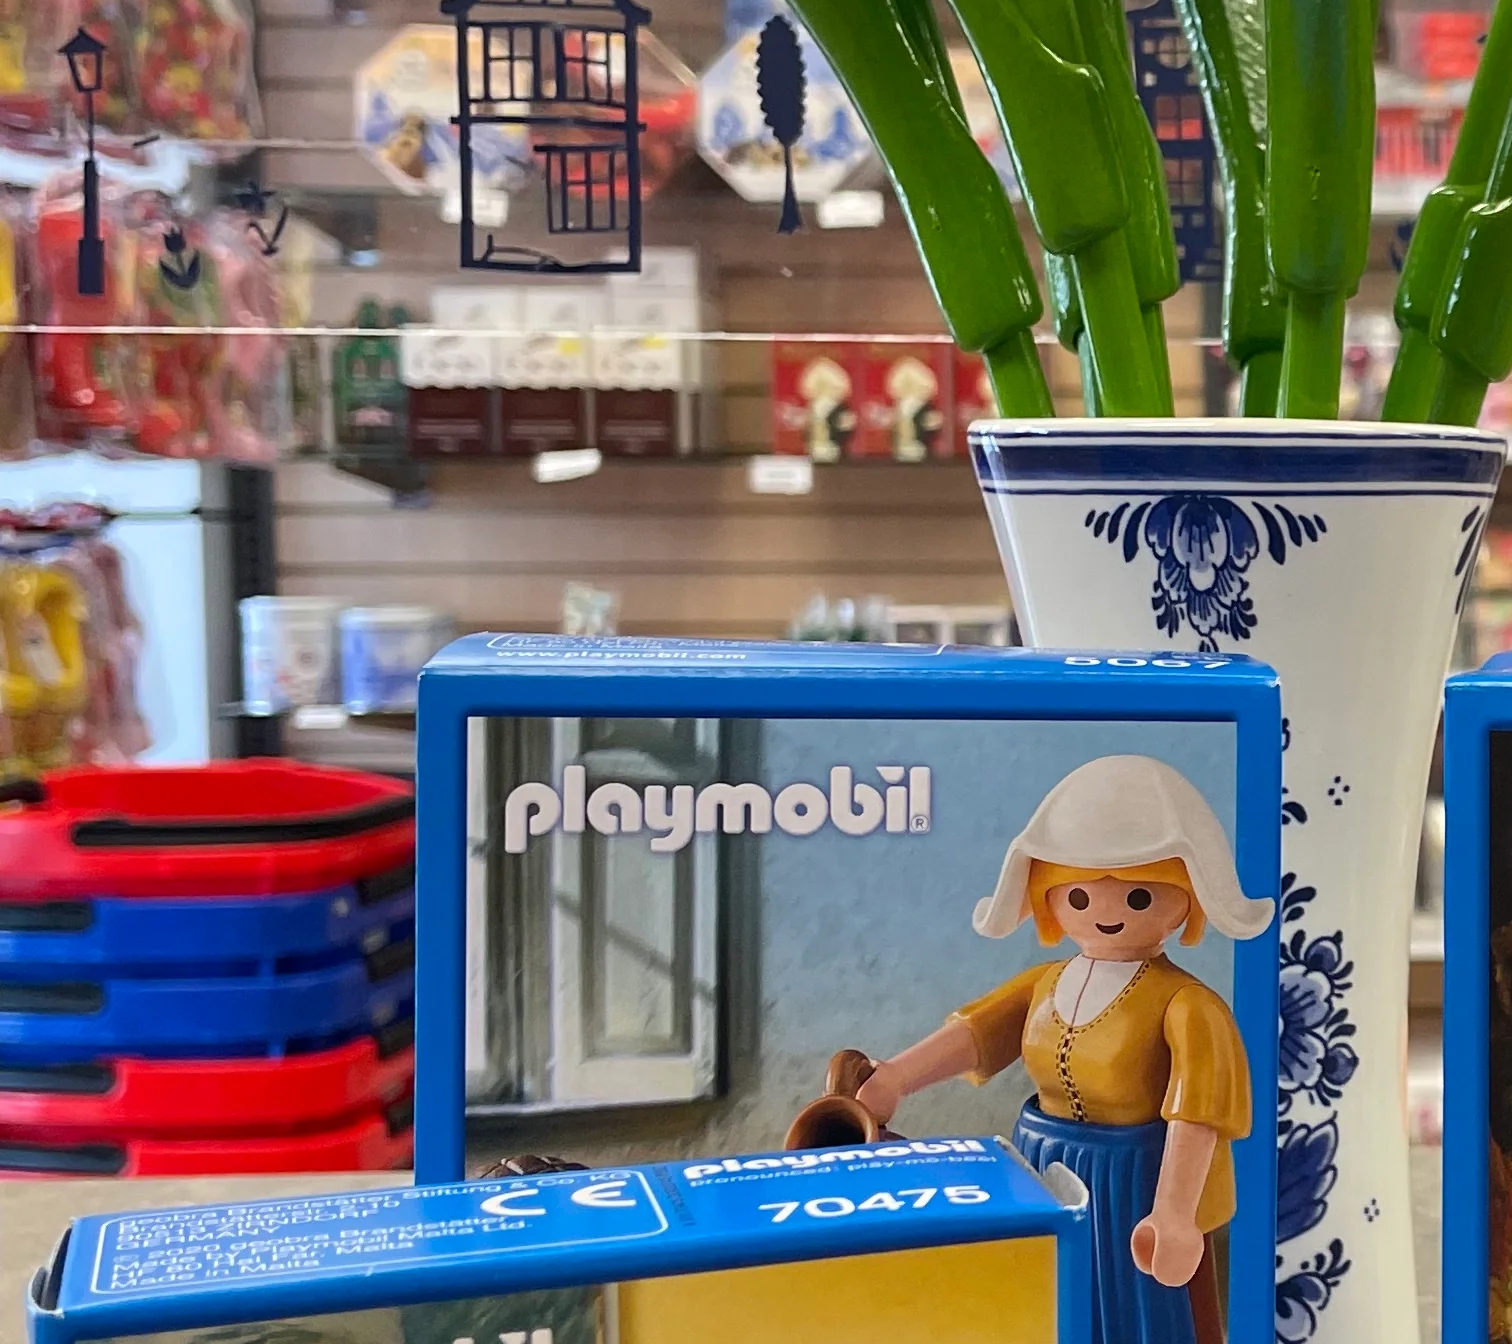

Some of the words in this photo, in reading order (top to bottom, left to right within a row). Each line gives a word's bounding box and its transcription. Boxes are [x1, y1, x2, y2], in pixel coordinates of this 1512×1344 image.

[497, 651, 746, 659] www.playmobil.com
[1064, 656, 1231, 669] 5067
[683, 1140, 986, 1180] playmobil
[758, 1185, 991, 1223] 70475
[110, 1272, 194, 1289] Made
[240, 1258, 319, 1273] Malta
[113, 1255, 195, 1271] Made
